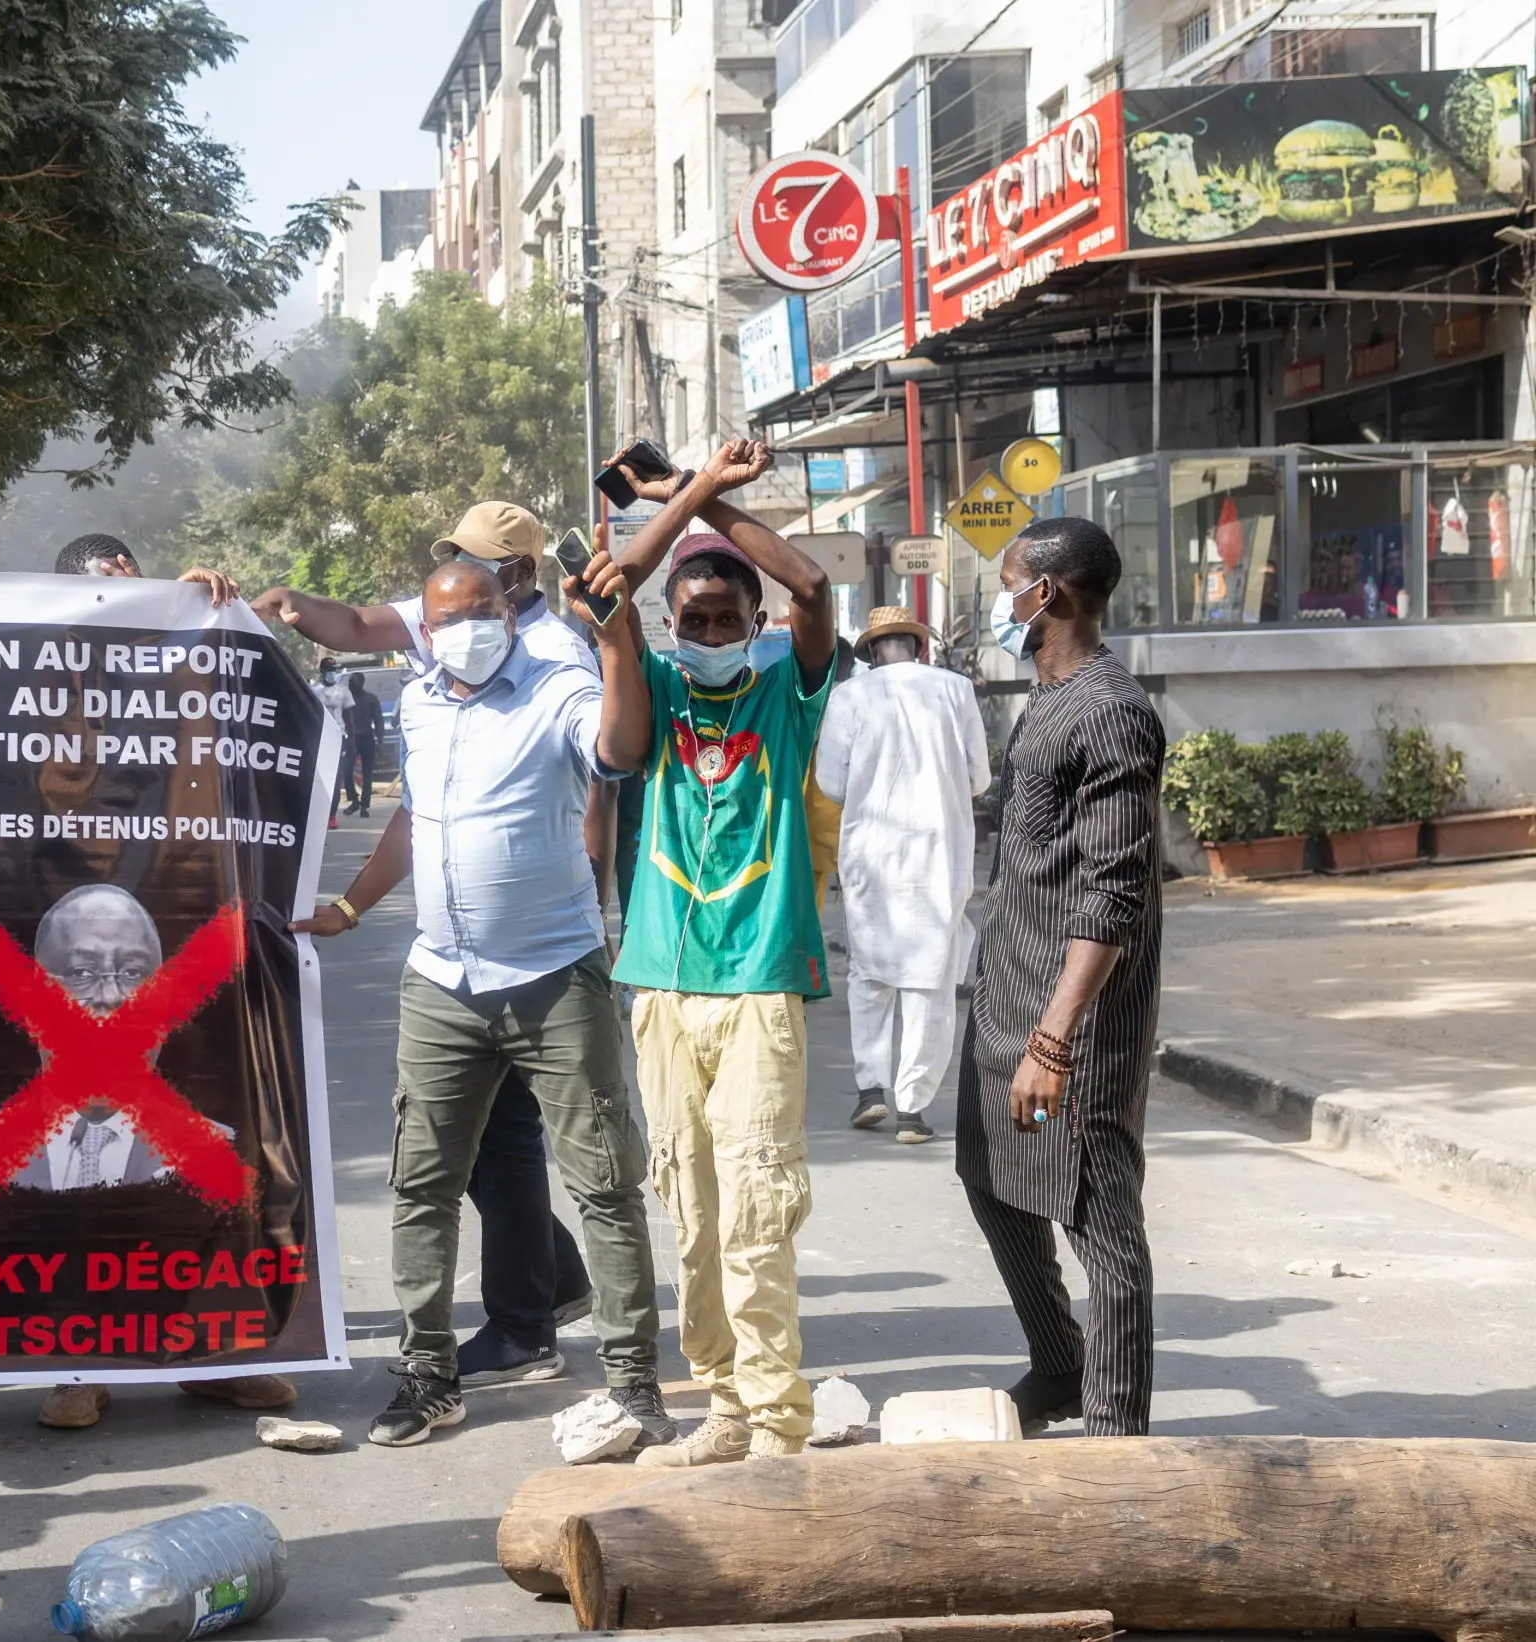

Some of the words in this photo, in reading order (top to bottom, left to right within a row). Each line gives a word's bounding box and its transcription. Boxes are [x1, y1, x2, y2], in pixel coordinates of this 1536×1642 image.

[927, 197, 967, 268] LE
[994, 113, 1101, 227] CINQ
[758, 199, 790, 223] LE
[772, 171, 843, 264] 7
[814, 224, 857, 244] CINQ
[786, 257, 844, 271] RESTAURANT
[962, 248, 1064, 317] RESTAURANT
[1023, 458, 1038, 468] 30
[960, 501, 1015, 515] ARRET
[962, 518, 986, 528] MINI
[990, 518, 1011, 527] BUS
[899, 551, 938, 559] AUTOBUS
[903, 542, 932, 550] ARRET
[907, 560, 929, 569] DDD
[34, 641, 91, 672] AU
[105, 644, 262, 678] REPORT
[10, 687, 68, 717] AU
[84, 689, 278, 727] DIALOGUE
[96, 735, 177, 765] PAR
[192, 736, 303, 777] FORCE
[42, 810, 168, 841] DÉTENUS
[175, 817, 296, 847] POLITIQUES
[87, 1242, 308, 1292] DÉGAGE
